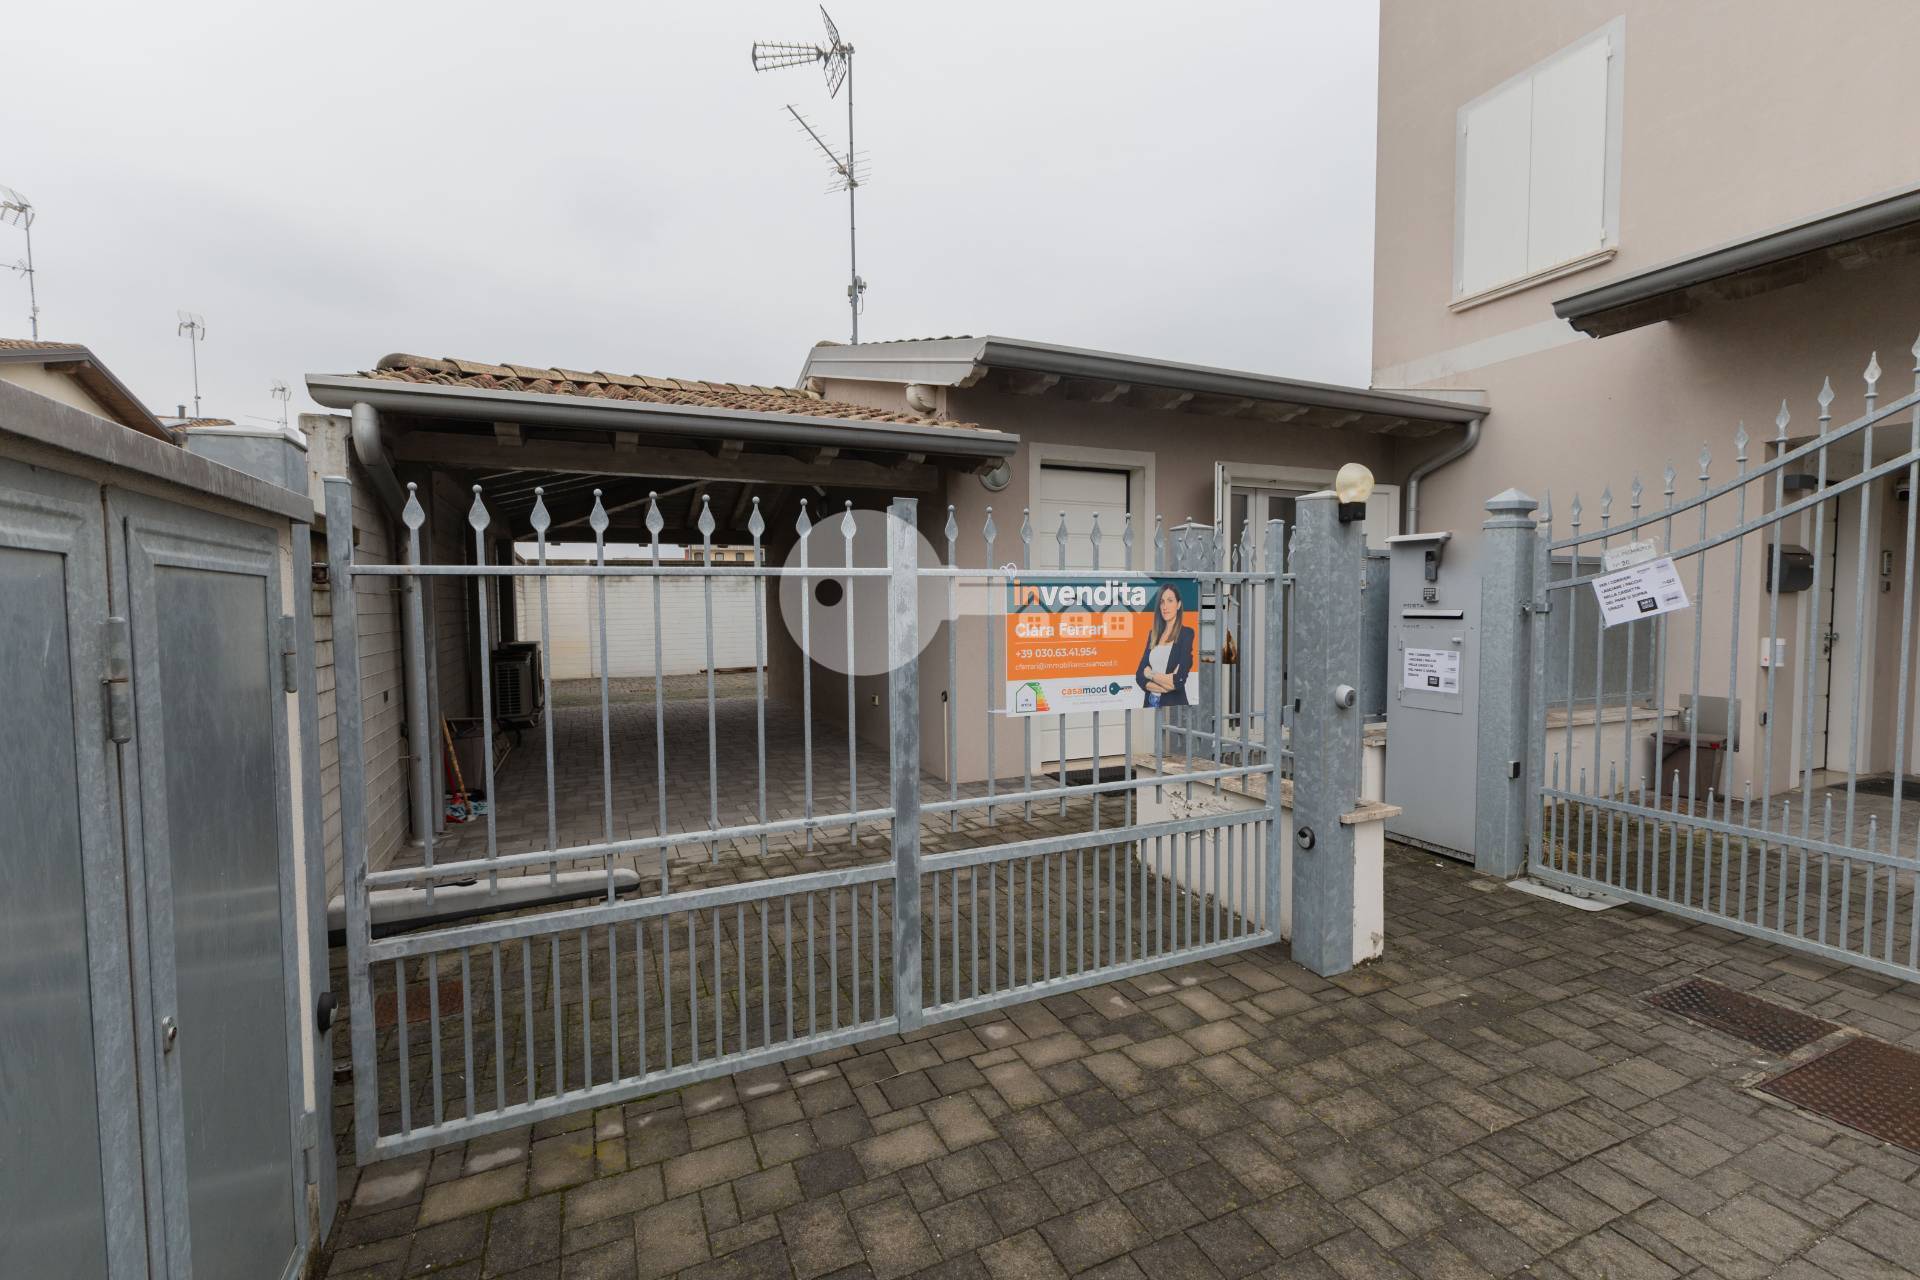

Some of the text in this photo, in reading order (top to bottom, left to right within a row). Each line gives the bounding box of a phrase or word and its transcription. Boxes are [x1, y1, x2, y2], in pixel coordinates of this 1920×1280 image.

[1013, 579, 1146, 607] invendita
[1015, 621, 1108, 638] Clara Ferrari
[1015, 647, 1097, 659] +39 030.63.41.954
[1061, 685, 1107, 696] casamood
